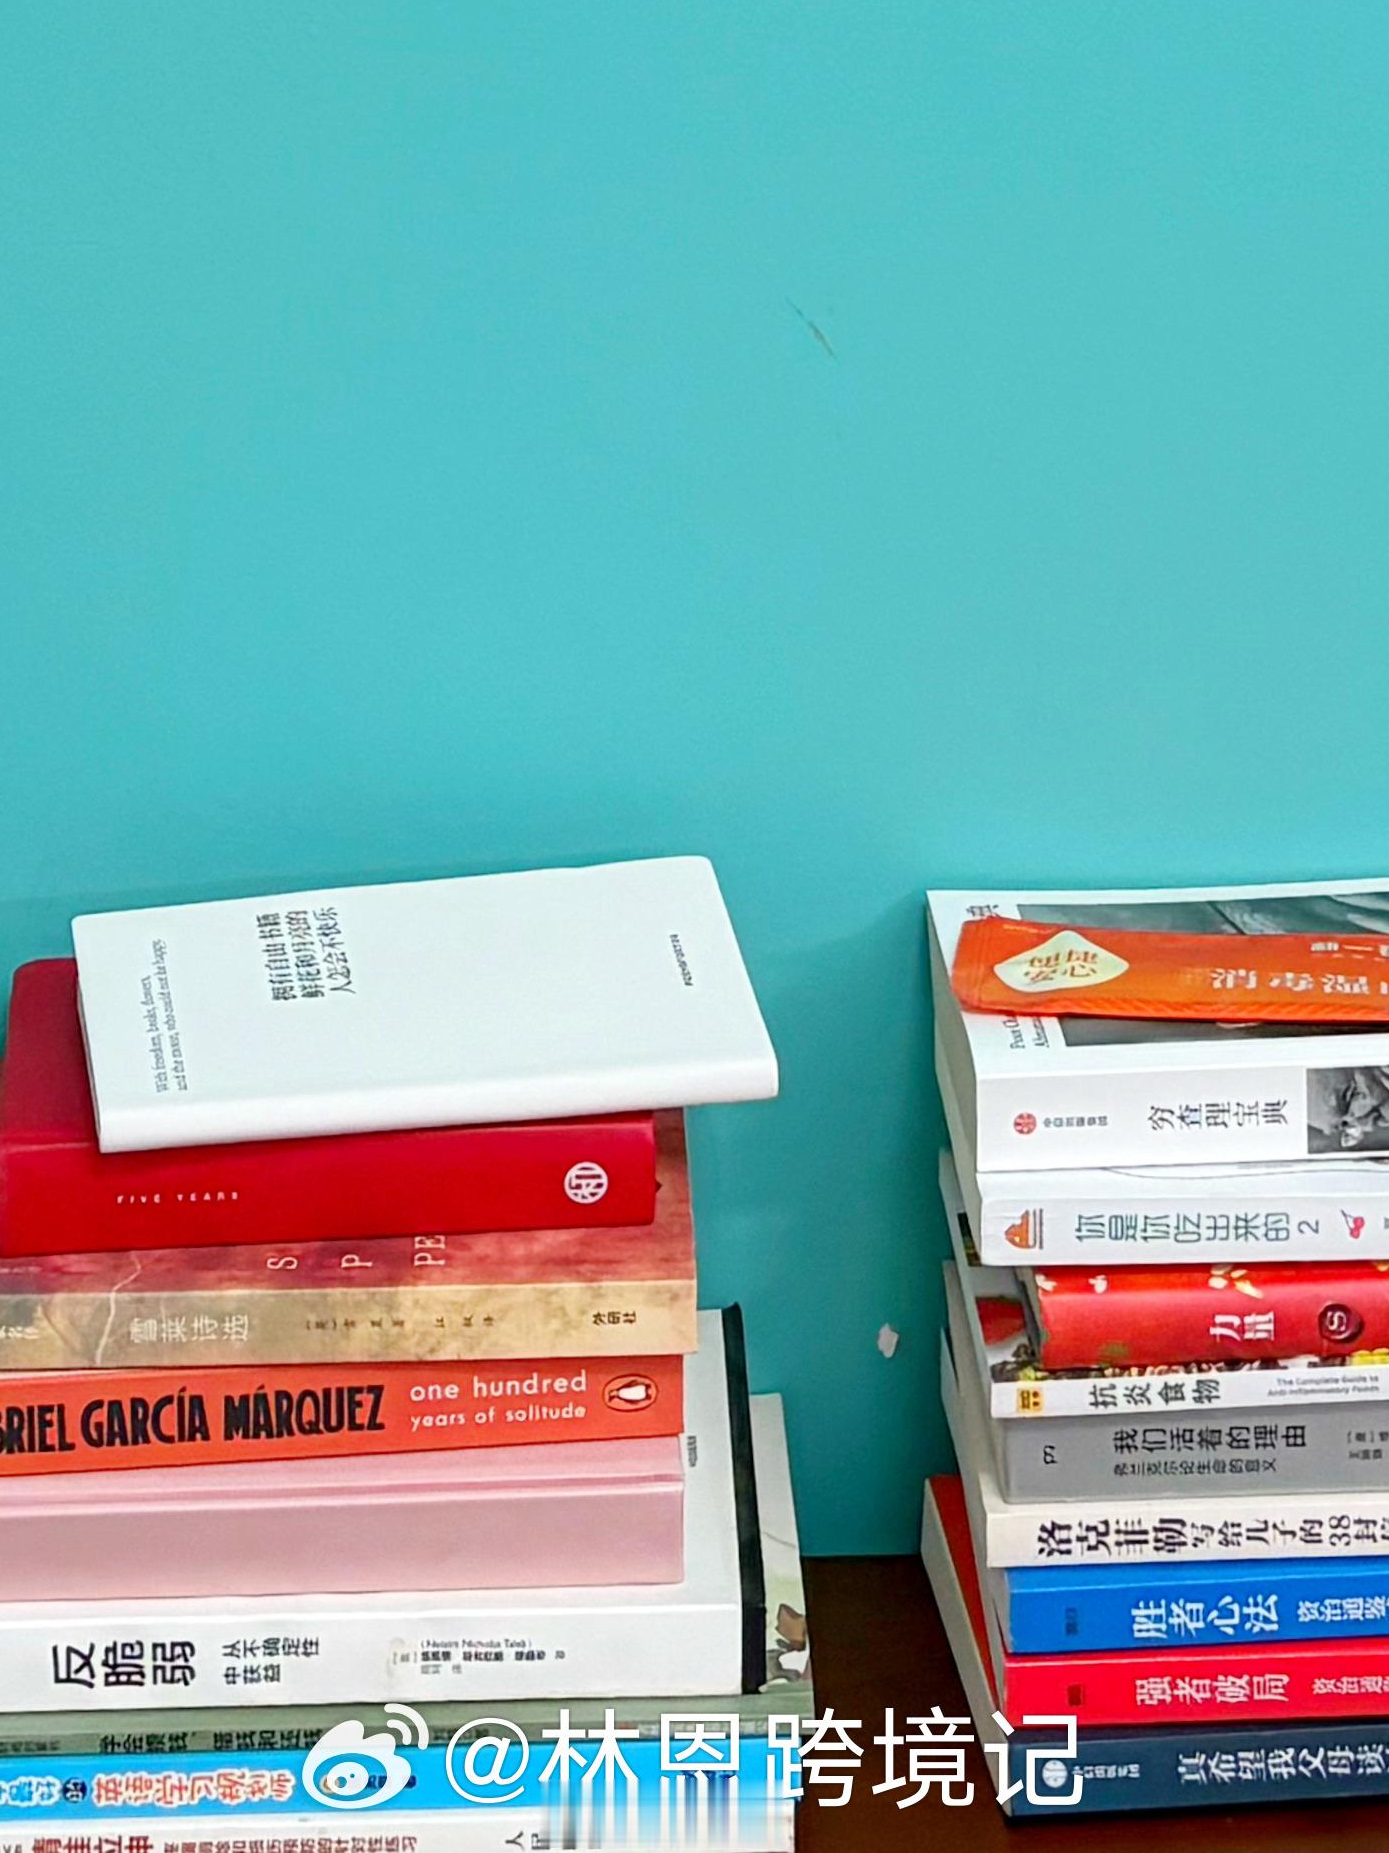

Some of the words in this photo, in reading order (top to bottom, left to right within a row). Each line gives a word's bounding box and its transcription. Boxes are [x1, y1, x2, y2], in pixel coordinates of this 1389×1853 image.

[257, 913, 297, 1002] 拥有自由书籍
[284, 910, 325, 998] 鲜花和月亮的
[312, 906, 356, 994] 人怎会不快乐
[1148, 1099, 1288, 1130] 穷查理宝典
[117, 1193, 162, 1204] FIVE
[177, 1191, 240, 1202] YEARS
[130, 1314, 249, 1344] 雪莱诗选
[592, 1310, 636, 1326] 外研社
[1210, 1311, 1275, 1342] 力量
[410, 1384, 459, 1402] one
[472, 1369, 587, 1398] hundred
[1089, 1379, 1220, 1409] 抗炎食物
[80, 1387, 208, 1448] GARCÍA
[223, 1384, 386, 1443] MÁRQUEZ
[410, 1410, 466, 1431] years
[475, 1408, 495, 1425] of
[505, 1403, 587, 1422] solitude
[1113, 1424, 1307, 1453] 我们活着的理由
[1113, 1457, 1276, 1476] 弗兰克尔论生命的意义
[1131, 1594, 1278, 1639] 胜者心法
[221, 1637, 320, 1658] 从不确定性
[52, 1640, 196, 1689] 反脆弱
[224, 1665, 282, 1685] 中获益
[1135, 1673, 1290, 1706] 强者破局
